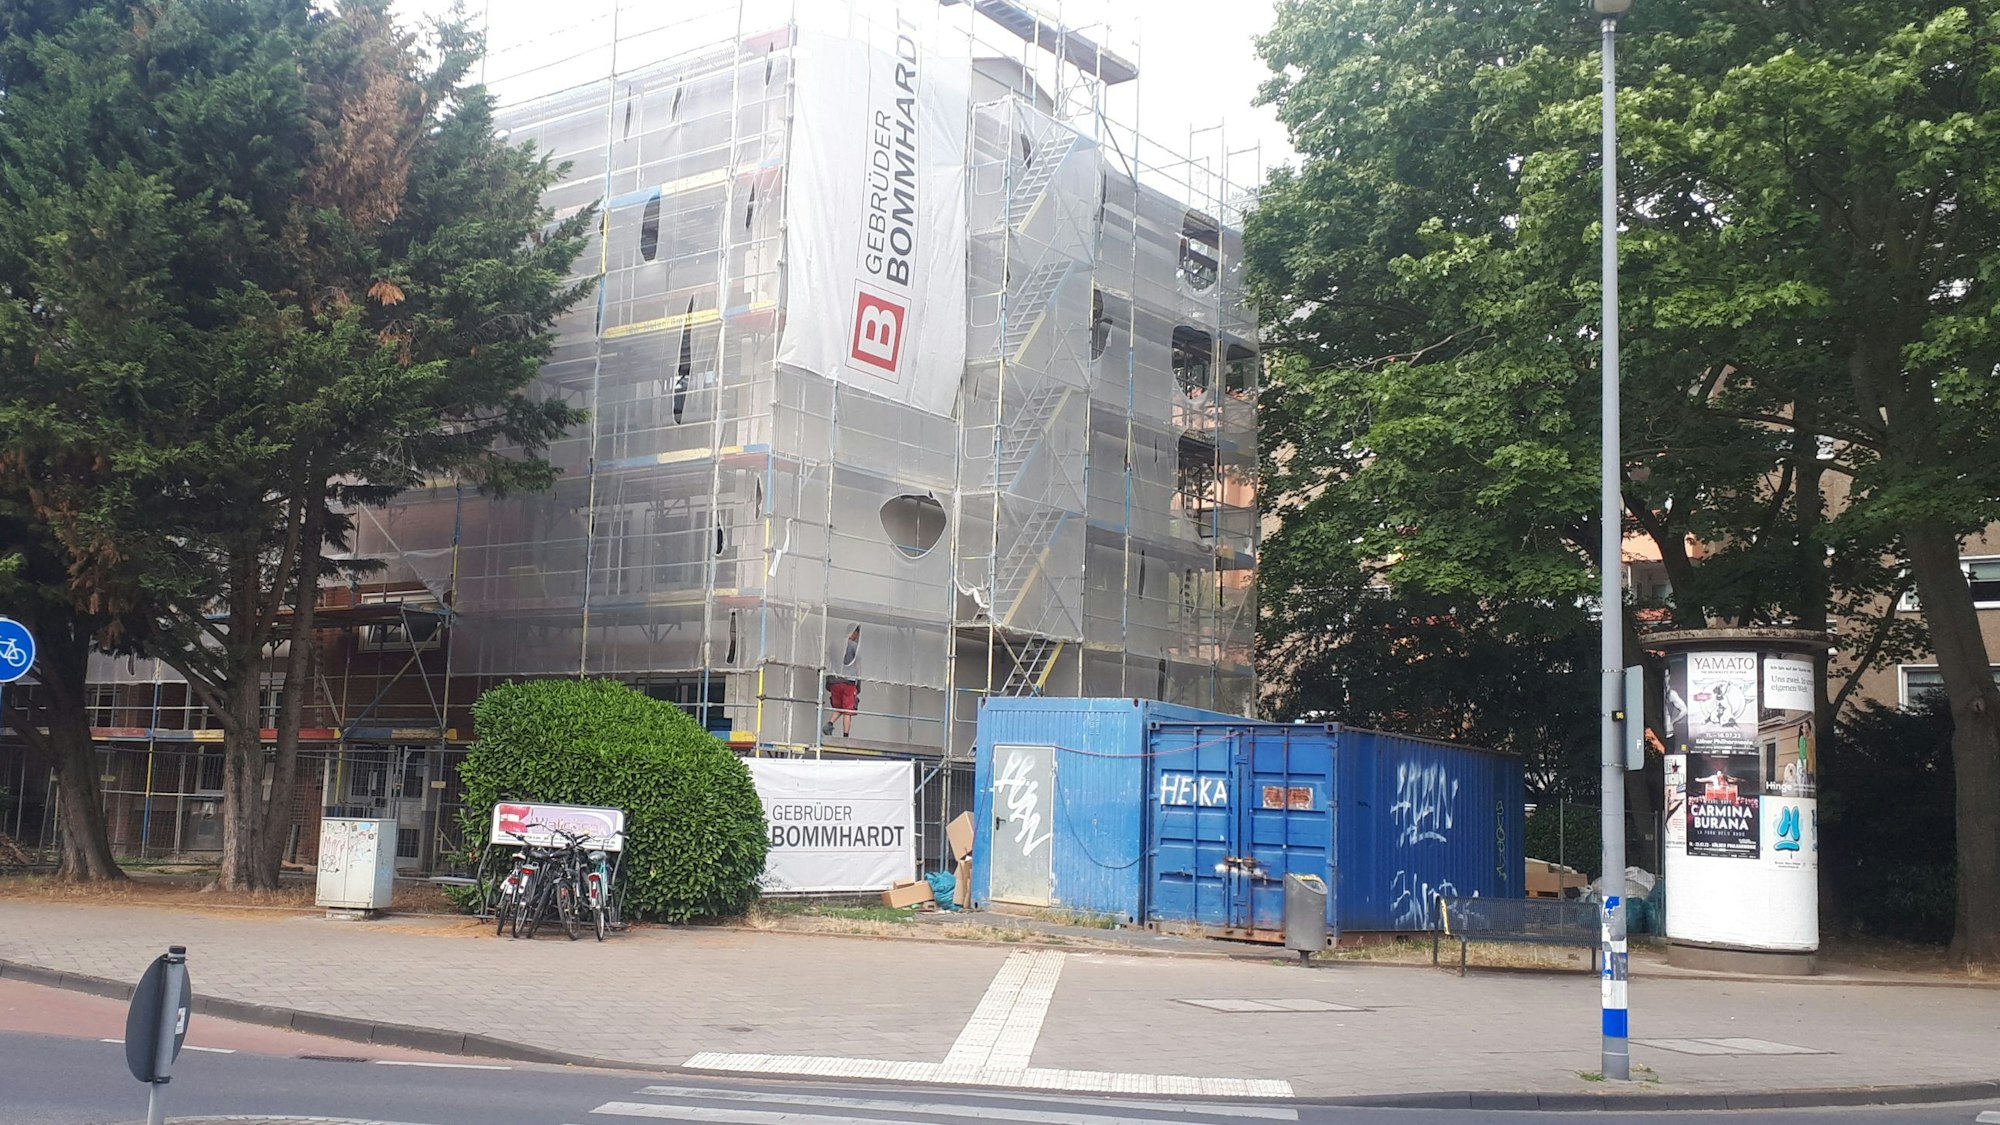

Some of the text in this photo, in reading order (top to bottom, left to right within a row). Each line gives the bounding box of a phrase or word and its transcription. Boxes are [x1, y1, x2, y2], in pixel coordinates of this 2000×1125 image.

[886, 7, 917, 287] BOMMHARDT
[866, 110, 891, 275] GEBRÜDER
[1694, 657, 1755, 670] YAMATO
[1765, 781, 1793, 792] Hinge
[772, 802, 853, 822] GEBRÜDER
[1690, 804, 1753, 818] CARMINA
[1694, 817, 1749, 830] BURANA
[772, 825, 905, 848] BOMMHARDT
